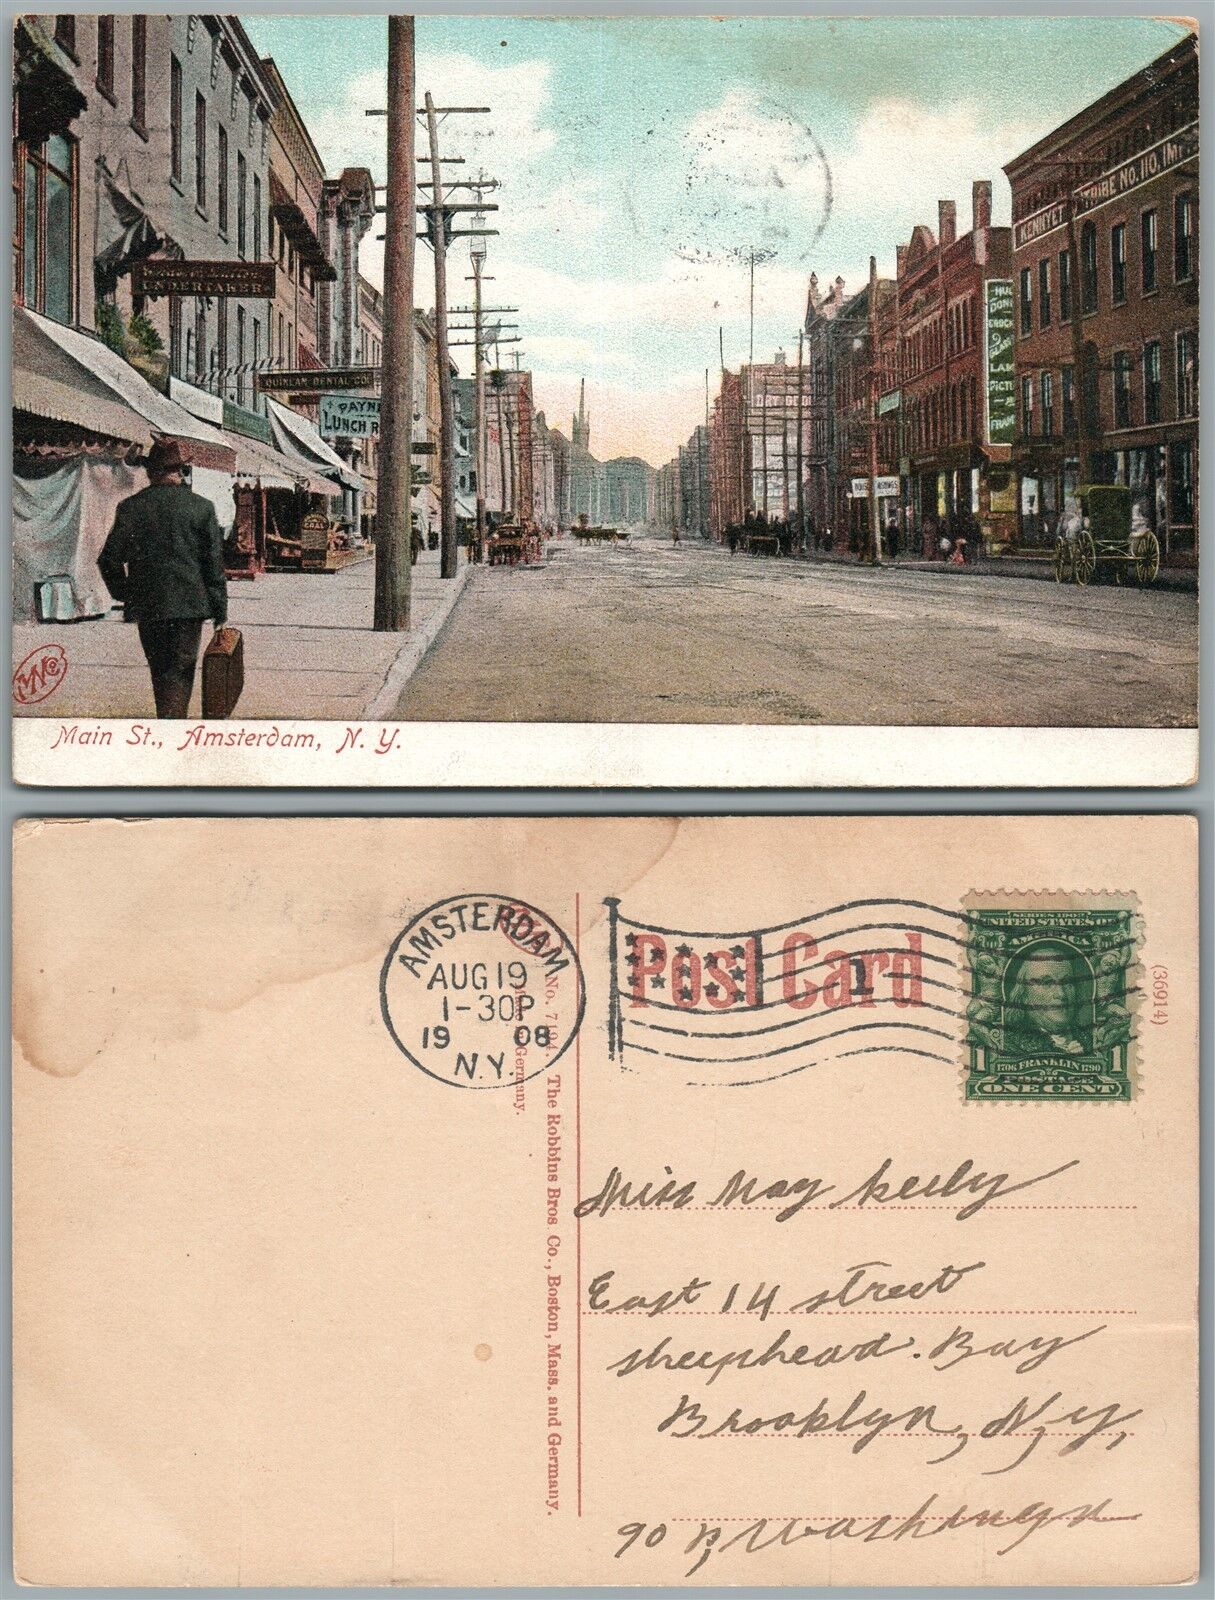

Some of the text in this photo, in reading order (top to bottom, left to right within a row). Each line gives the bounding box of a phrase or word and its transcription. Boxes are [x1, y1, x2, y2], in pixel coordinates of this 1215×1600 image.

[322, 409, 367, 433] LUNCH
[50, 724, 113, 749] Main
[126, 725, 163, 750] St.,
[177, 725, 322, 751] Amsterdam,
[399, 902, 570, 979] AMSTERDAM
[1037, 918, 1094, 927] STATES
[427, 961, 528, 990] AUG 19
[545, 975, 560, 1006] No.
[628, 932, 926, 1010] Post Card
[1150, 964, 1169, 1026] (36914)
[422, 1025, 551, 1049] 19 08
[513, 1046, 528, 1116] Germany.
[1018, 1057, 1081, 1071] FRANKLIN
[547, 1075, 561, 1108] The
[981, 1084, 1115, 1094] ONE CENT
[547, 1113, 561, 1182] Robbins
[574, 1166, 697, 1217] Miss
[706, 1169, 836, 1222] May
[544, 1274, 562, 1339] Boston,
[588, 1270, 712, 1318] East
[720, 1282, 781, 1321] 14
[547, 1343, 562, 1391] Mass.
[928, 1324, 1108, 1375] Bay
[547, 1396, 562, 1428] and
[545, 1432, 562, 1516] Germany.
